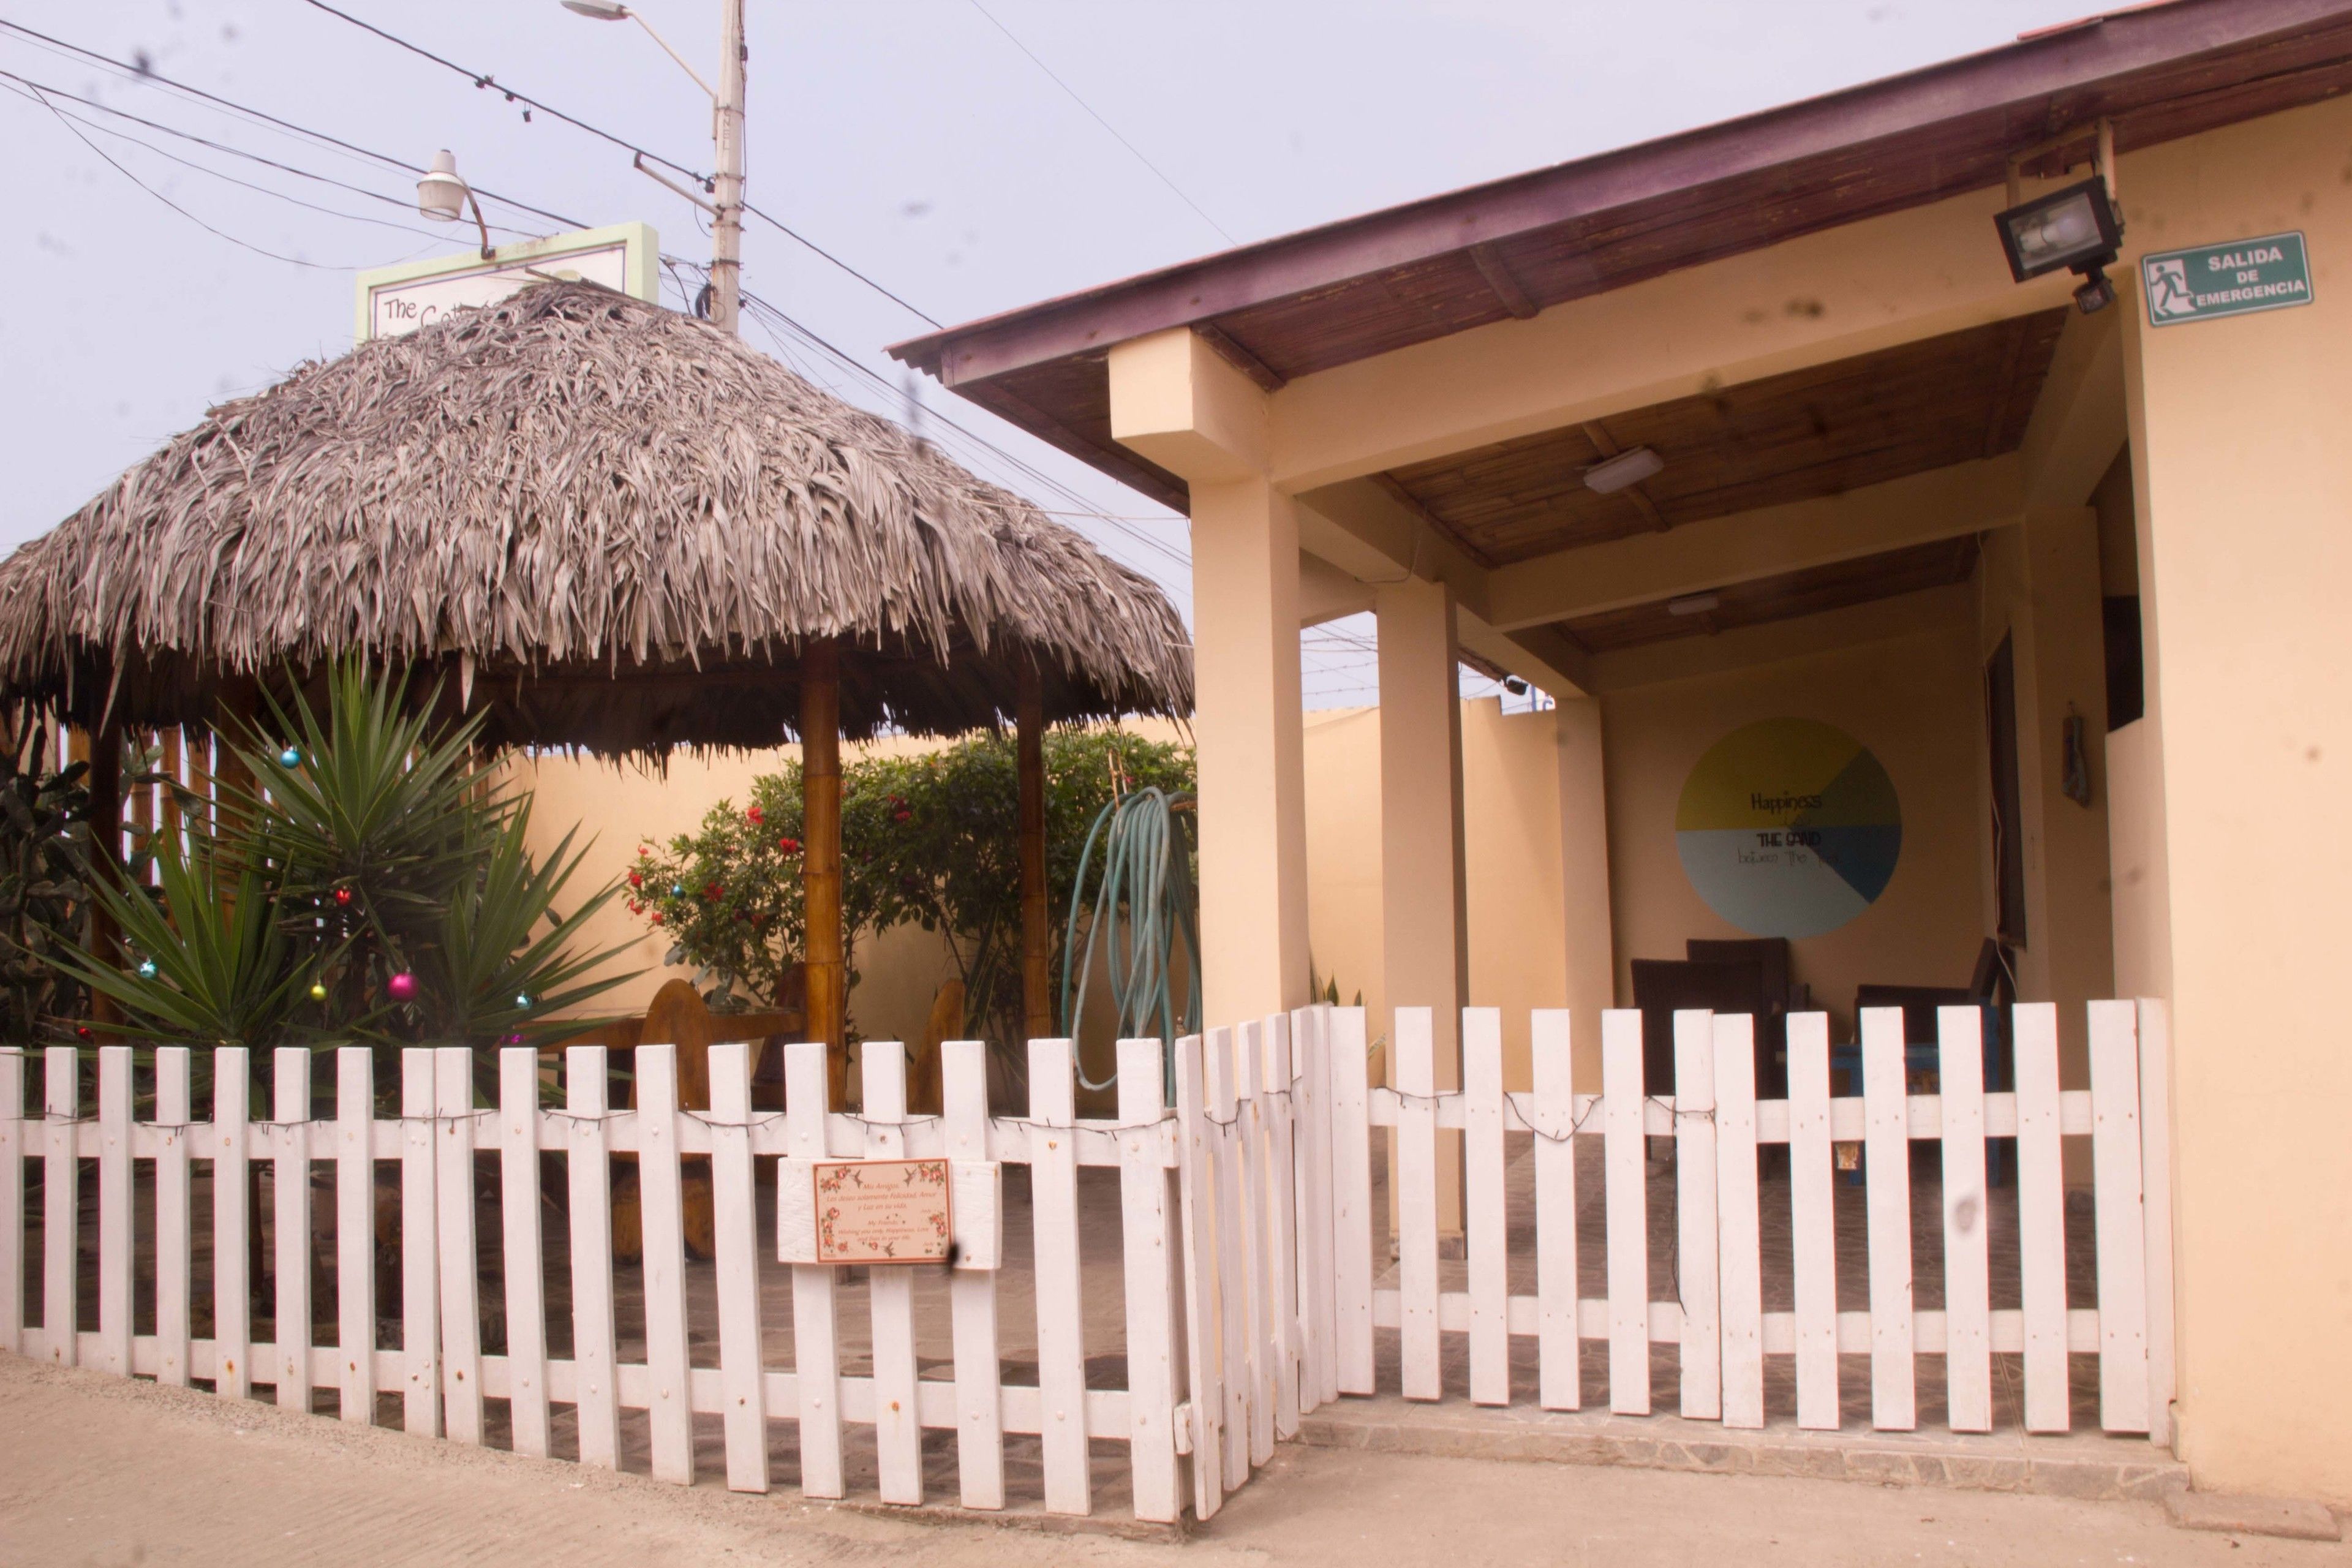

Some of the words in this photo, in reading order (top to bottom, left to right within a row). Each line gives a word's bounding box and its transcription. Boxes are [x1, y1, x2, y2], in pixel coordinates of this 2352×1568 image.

[2207, 246, 2283, 271] SALIDA
[2236, 269, 2260, 285] DE
[2196, 279, 2306, 307] EMERGENCIA
[384, 298, 417, 319] The
[1750, 790, 1823, 815] Happiness
[1756, 831, 1783, 848] THE
